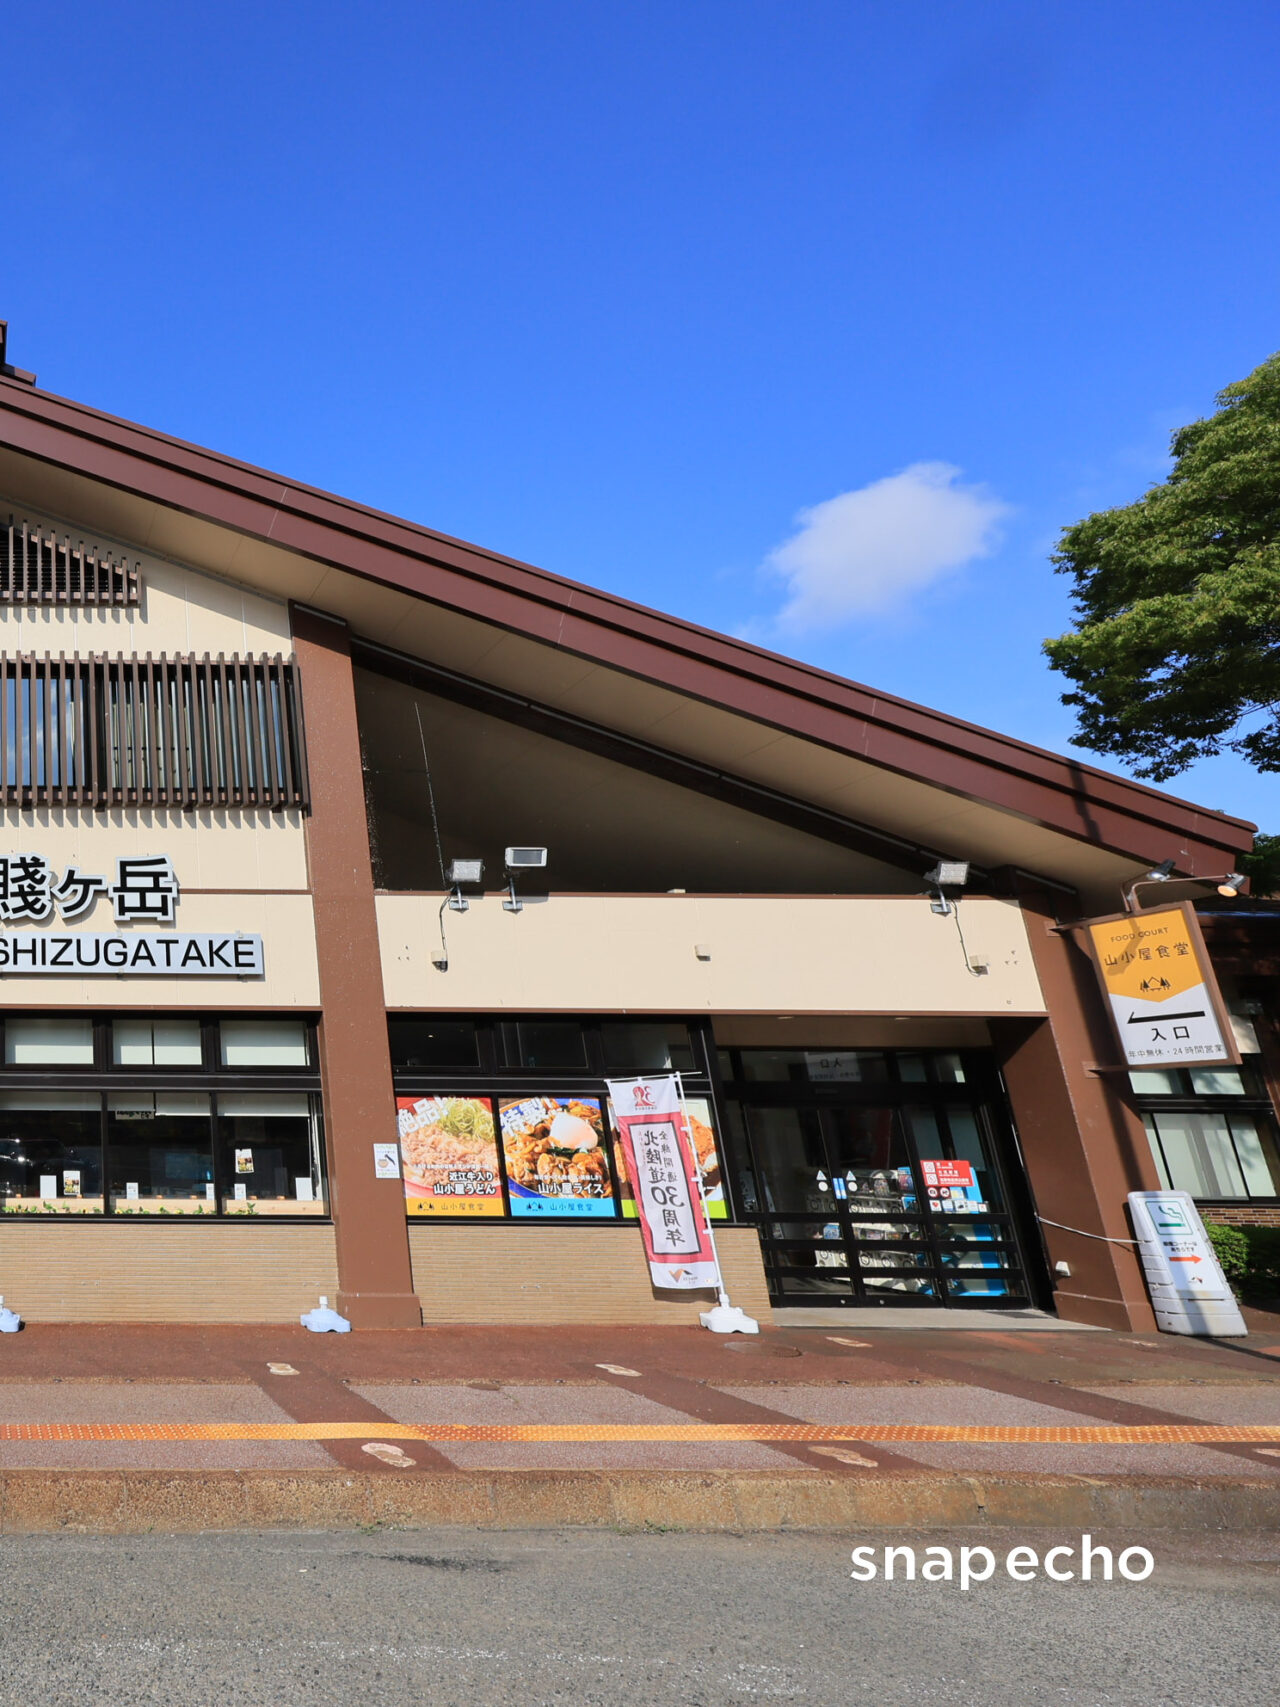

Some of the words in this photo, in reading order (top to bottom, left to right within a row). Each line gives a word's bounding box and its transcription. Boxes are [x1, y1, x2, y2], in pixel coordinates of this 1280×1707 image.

[1111, 933, 1136, 942] FOOD
[1138, 927, 1169, 938] COURT
[1104, 942, 1189, 966] 山小屋食堂
[1151, 1026, 1190, 1041] 入口
[434, 1183, 496, 1195] 山小屋うどん
[538, 1182, 604, 1195] 山小屋ライス
